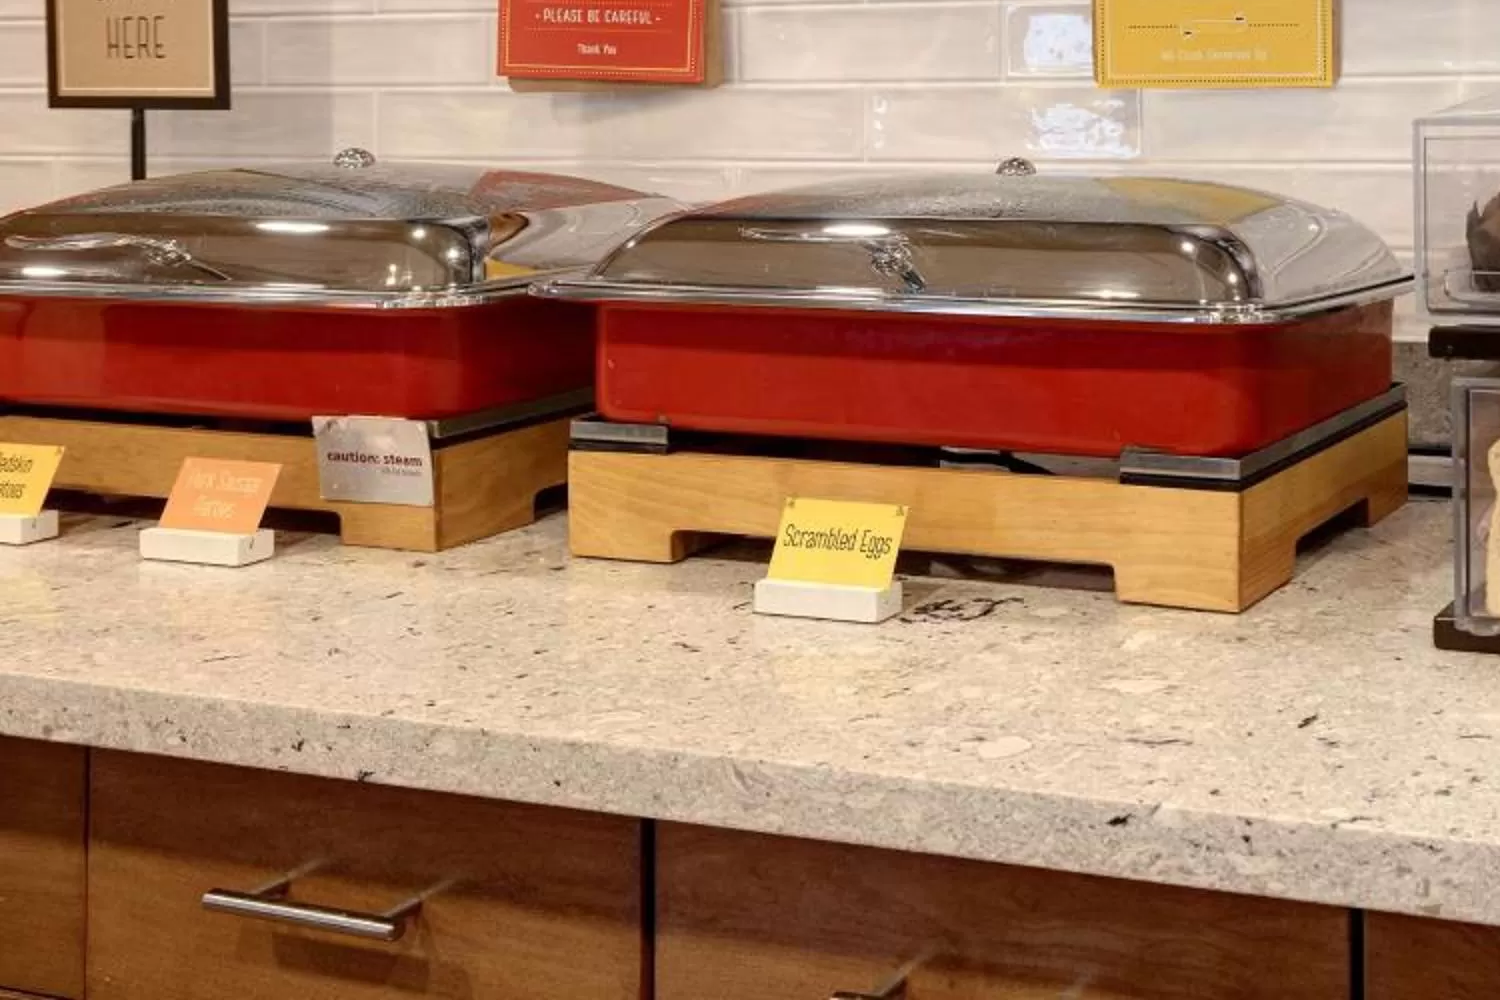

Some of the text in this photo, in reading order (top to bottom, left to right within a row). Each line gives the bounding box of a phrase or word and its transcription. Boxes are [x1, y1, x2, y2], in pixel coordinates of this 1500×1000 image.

[543, 7, 583, 24] PLEASE
[604, 8, 653, 25] CAREFUL
[105, 15, 167, 60] HERE
[327, 450, 423, 468] caution: steam
[783, 523, 893, 560] Scrambled Eggs
